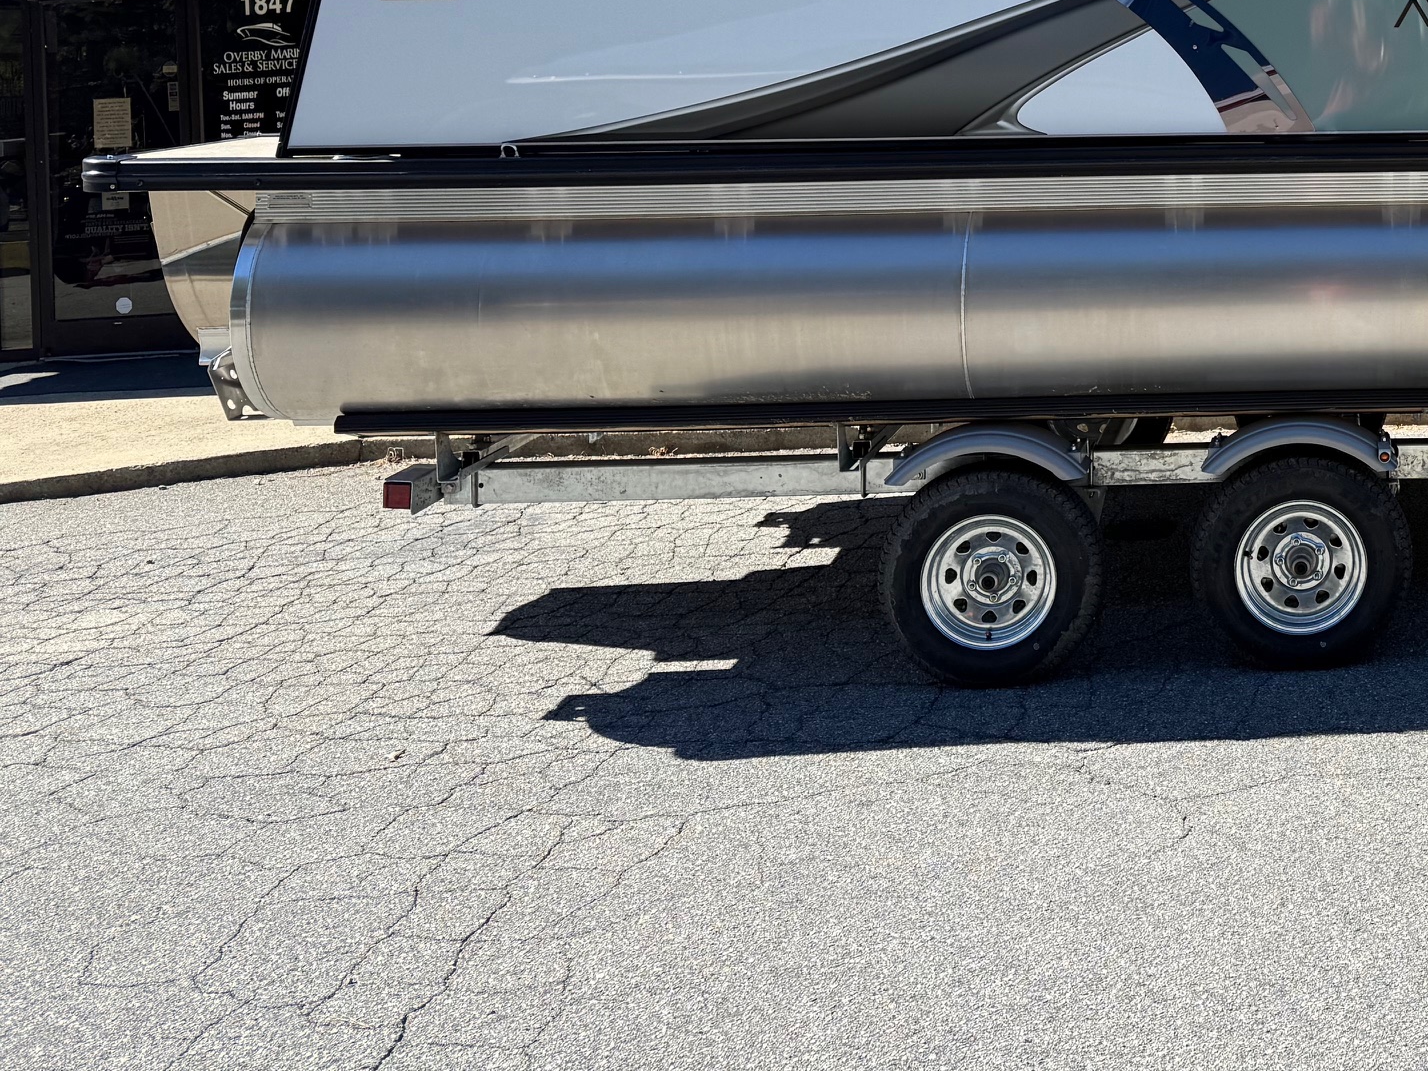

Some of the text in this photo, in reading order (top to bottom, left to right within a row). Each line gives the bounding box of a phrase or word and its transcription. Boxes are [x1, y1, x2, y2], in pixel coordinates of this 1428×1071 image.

[223, 50, 267, 63] OVERBY
[213, 62, 242, 75] SALES
[243, 60, 254, 72] &
[227, 77, 254, 87] HOURS
[254, 76, 265, 85] OF
[222, 90, 259, 101] Summer
[229, 100, 255, 111] Hours
[243, 121, 260, 129] Closed
